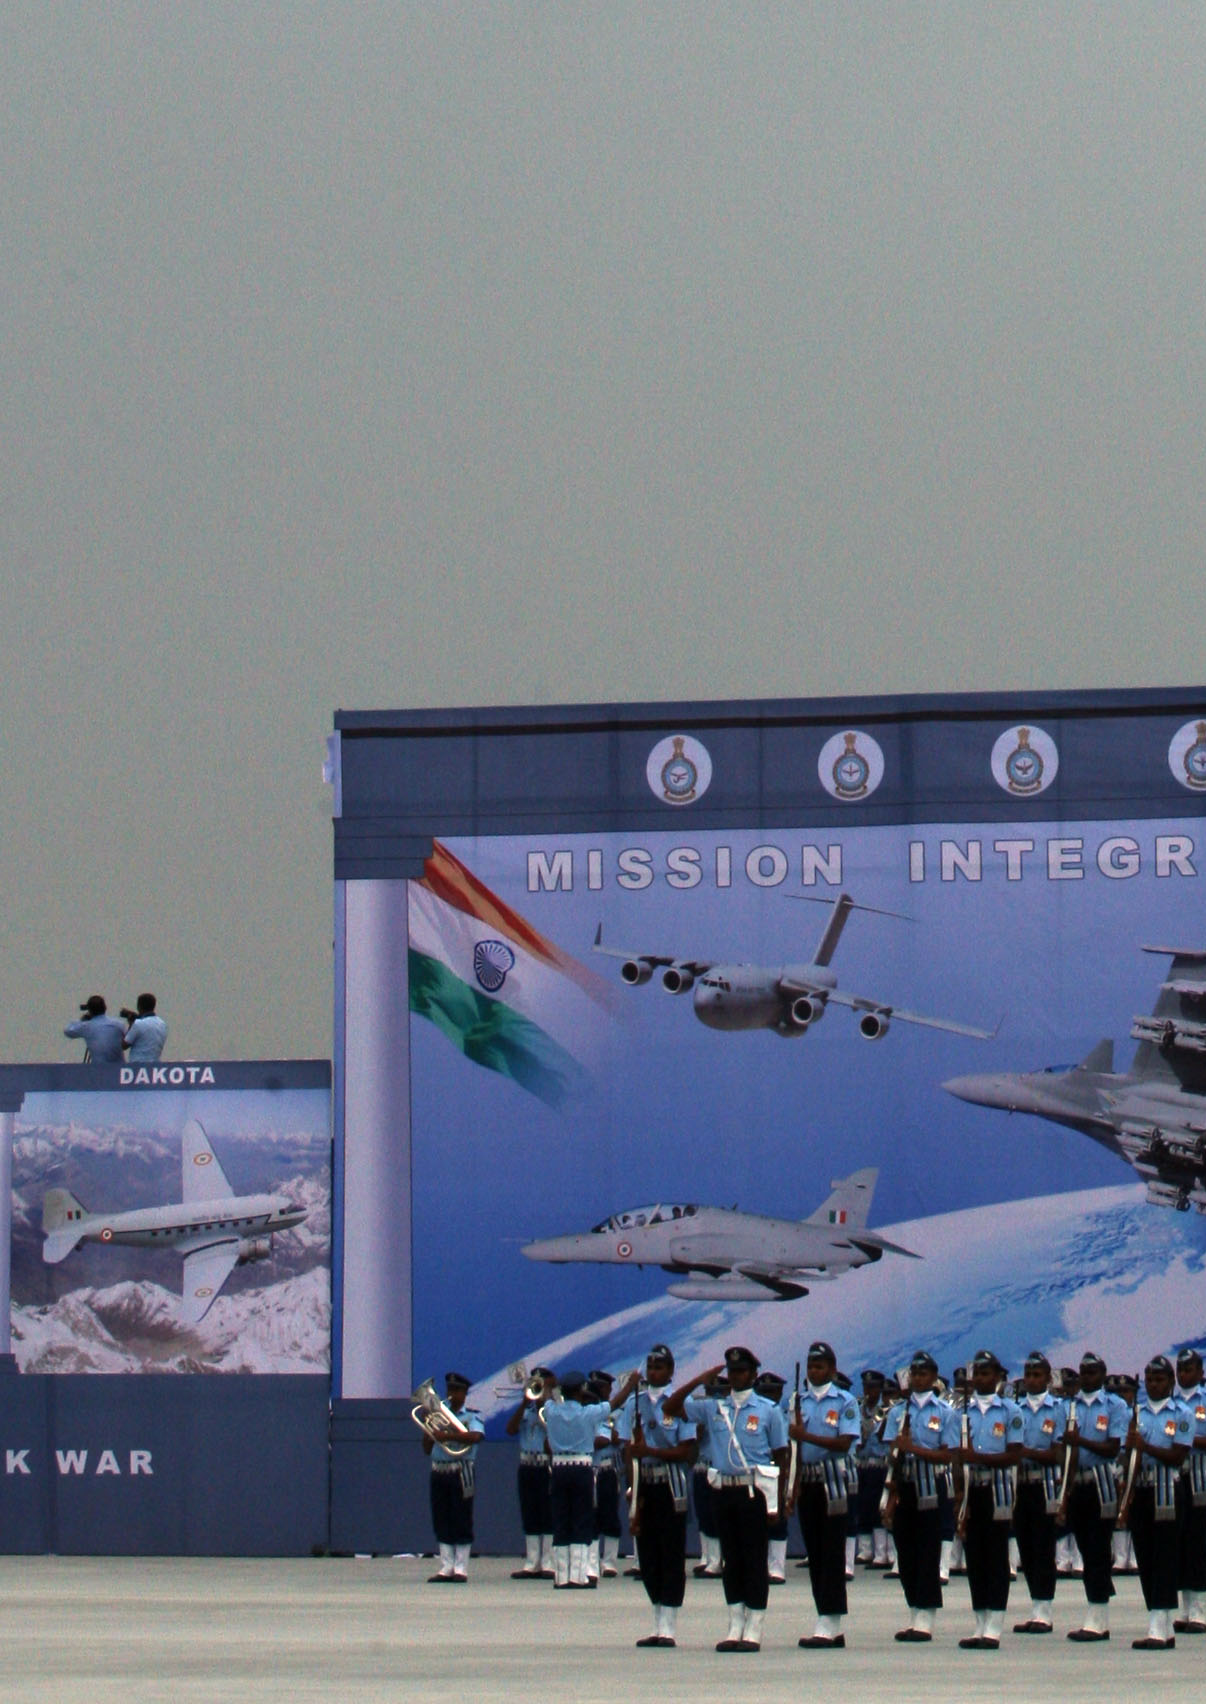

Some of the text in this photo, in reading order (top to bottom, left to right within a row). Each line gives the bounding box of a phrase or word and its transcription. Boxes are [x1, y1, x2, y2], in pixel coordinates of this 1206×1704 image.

[526, 844, 844, 893] MISSION
[120, 1066, 216, 1084] DAKOTA
[55, 1449, 154, 1475] WAR
